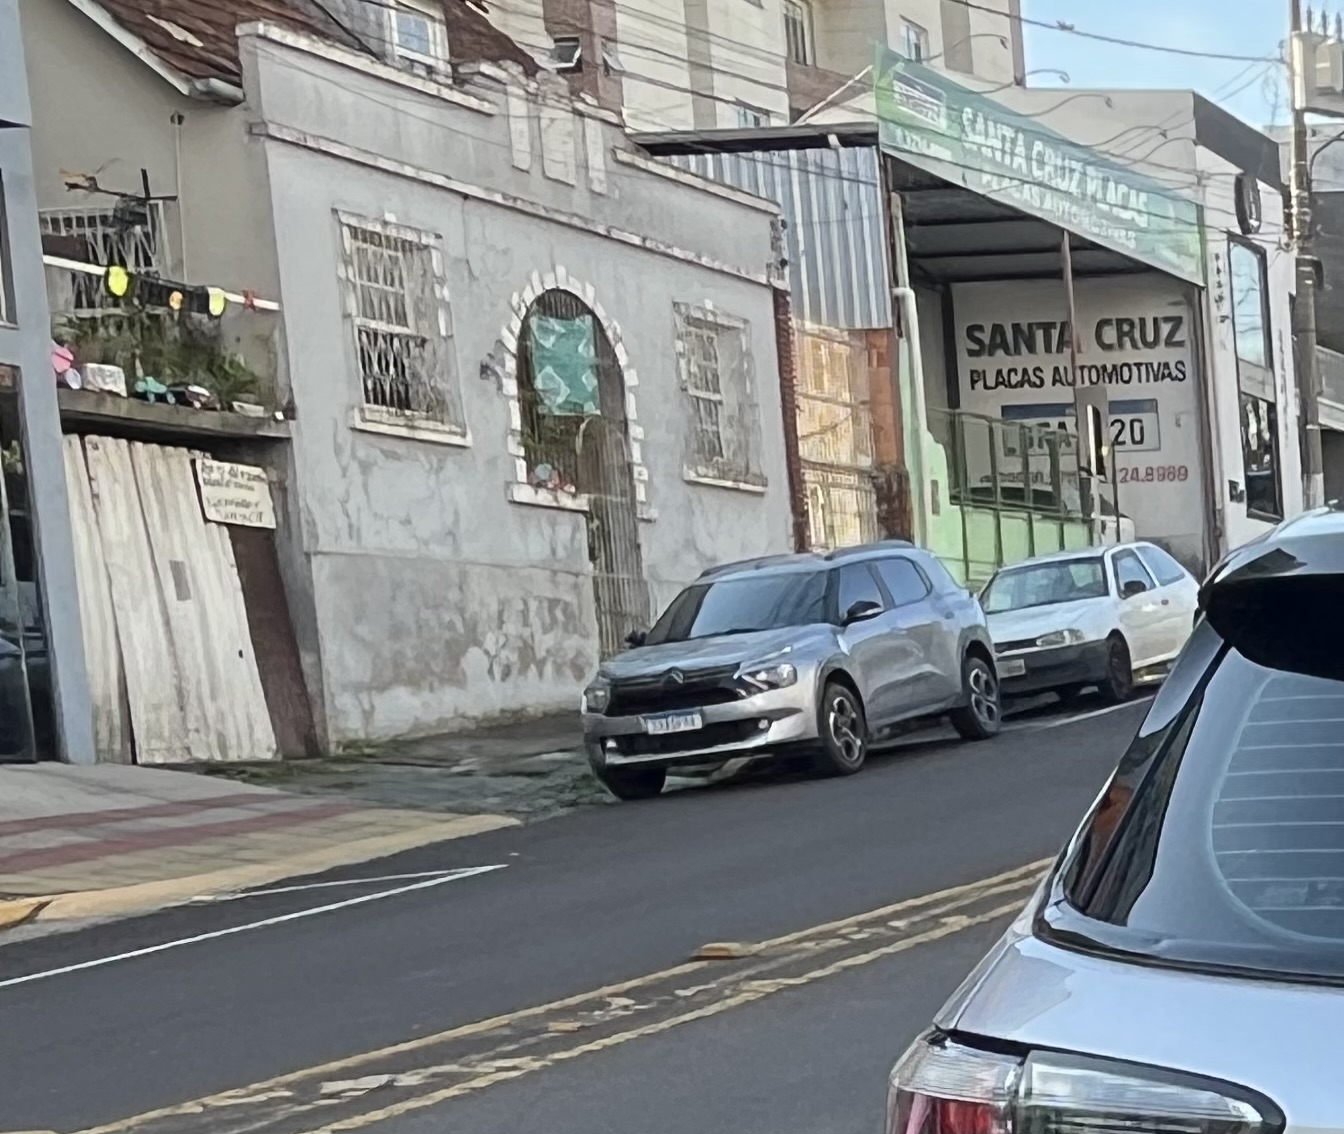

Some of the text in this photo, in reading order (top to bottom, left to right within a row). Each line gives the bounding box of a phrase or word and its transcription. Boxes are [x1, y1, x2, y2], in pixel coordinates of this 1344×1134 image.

[962, 107, 1027, 174] SANTA
[1031, 140, 1085, 198] CRUZ
[966, 315, 1185, 357] SANTA CRUZ
[970, 360, 1187, 390] PLACAS AUTOMOTIVAS
